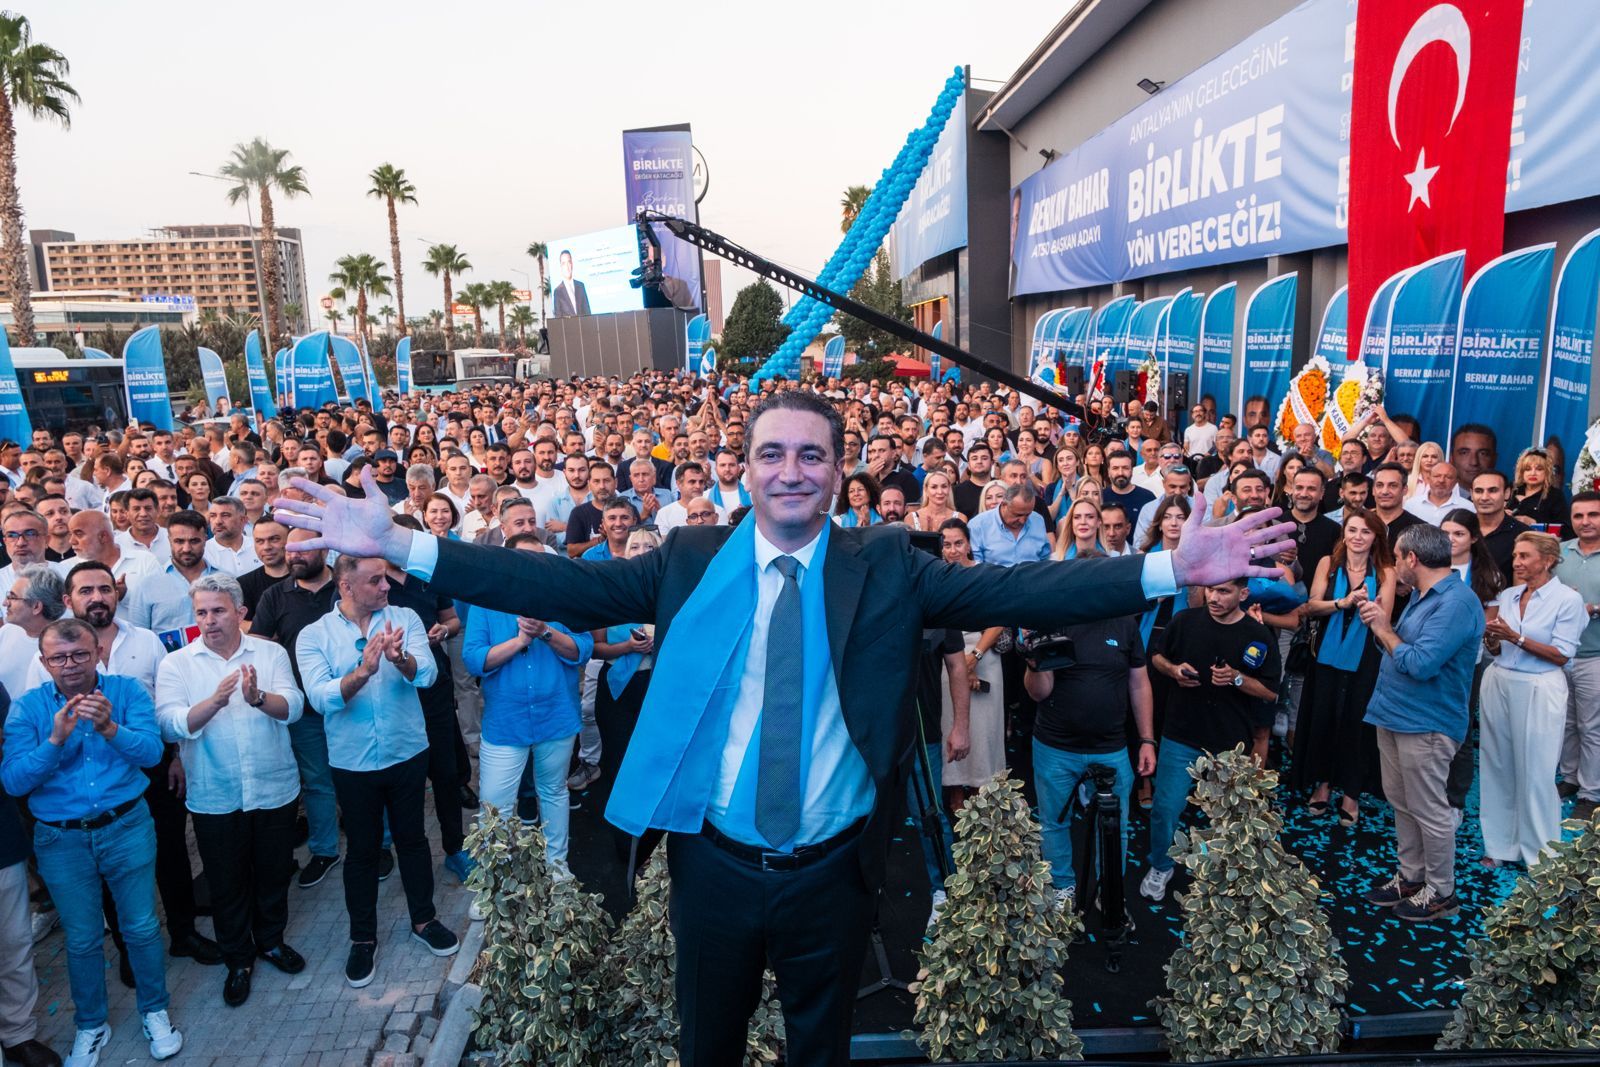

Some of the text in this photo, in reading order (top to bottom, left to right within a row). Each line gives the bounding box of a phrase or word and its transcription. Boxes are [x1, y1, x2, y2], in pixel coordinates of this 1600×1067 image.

[1129, 91, 1194, 146] ANTALYA'NIN
[1196, 36, 1289, 109] GELECEĞİNE
[632, 157, 684, 171] BİRLİKTE
[1127, 104, 1285, 224] BİRLİKTE
[1028, 167, 1109, 236] BERKAY BAHAR
[1077, 224, 1101, 247] ADAYI
[1127, 228, 1155, 268] YÖN
[1158, 193, 1282, 261] VERECEĞİZ!
[1204, 336, 1232, 347] BİRLİKTE
[1248, 333, 1292, 344] BİRLİKTE
[1322, 332, 1348, 346] BİRL
[1392, 332, 1455, 346] BİRLİKTE
[1462, 333, 1540, 350] BİRLİKTE
[1391, 346, 1454, 355] ÜRETECEĞİZ!
[1461, 349, 1538, 359] BAŞARACAĞIZ!
[128, 371, 164, 380] BİRLİKTE
[1394, 368, 1451, 378] BERKAY BAHAR
[1465, 372, 1534, 385] BERKAY BAHAR
[1331, 408, 1350, 437] KASAP
